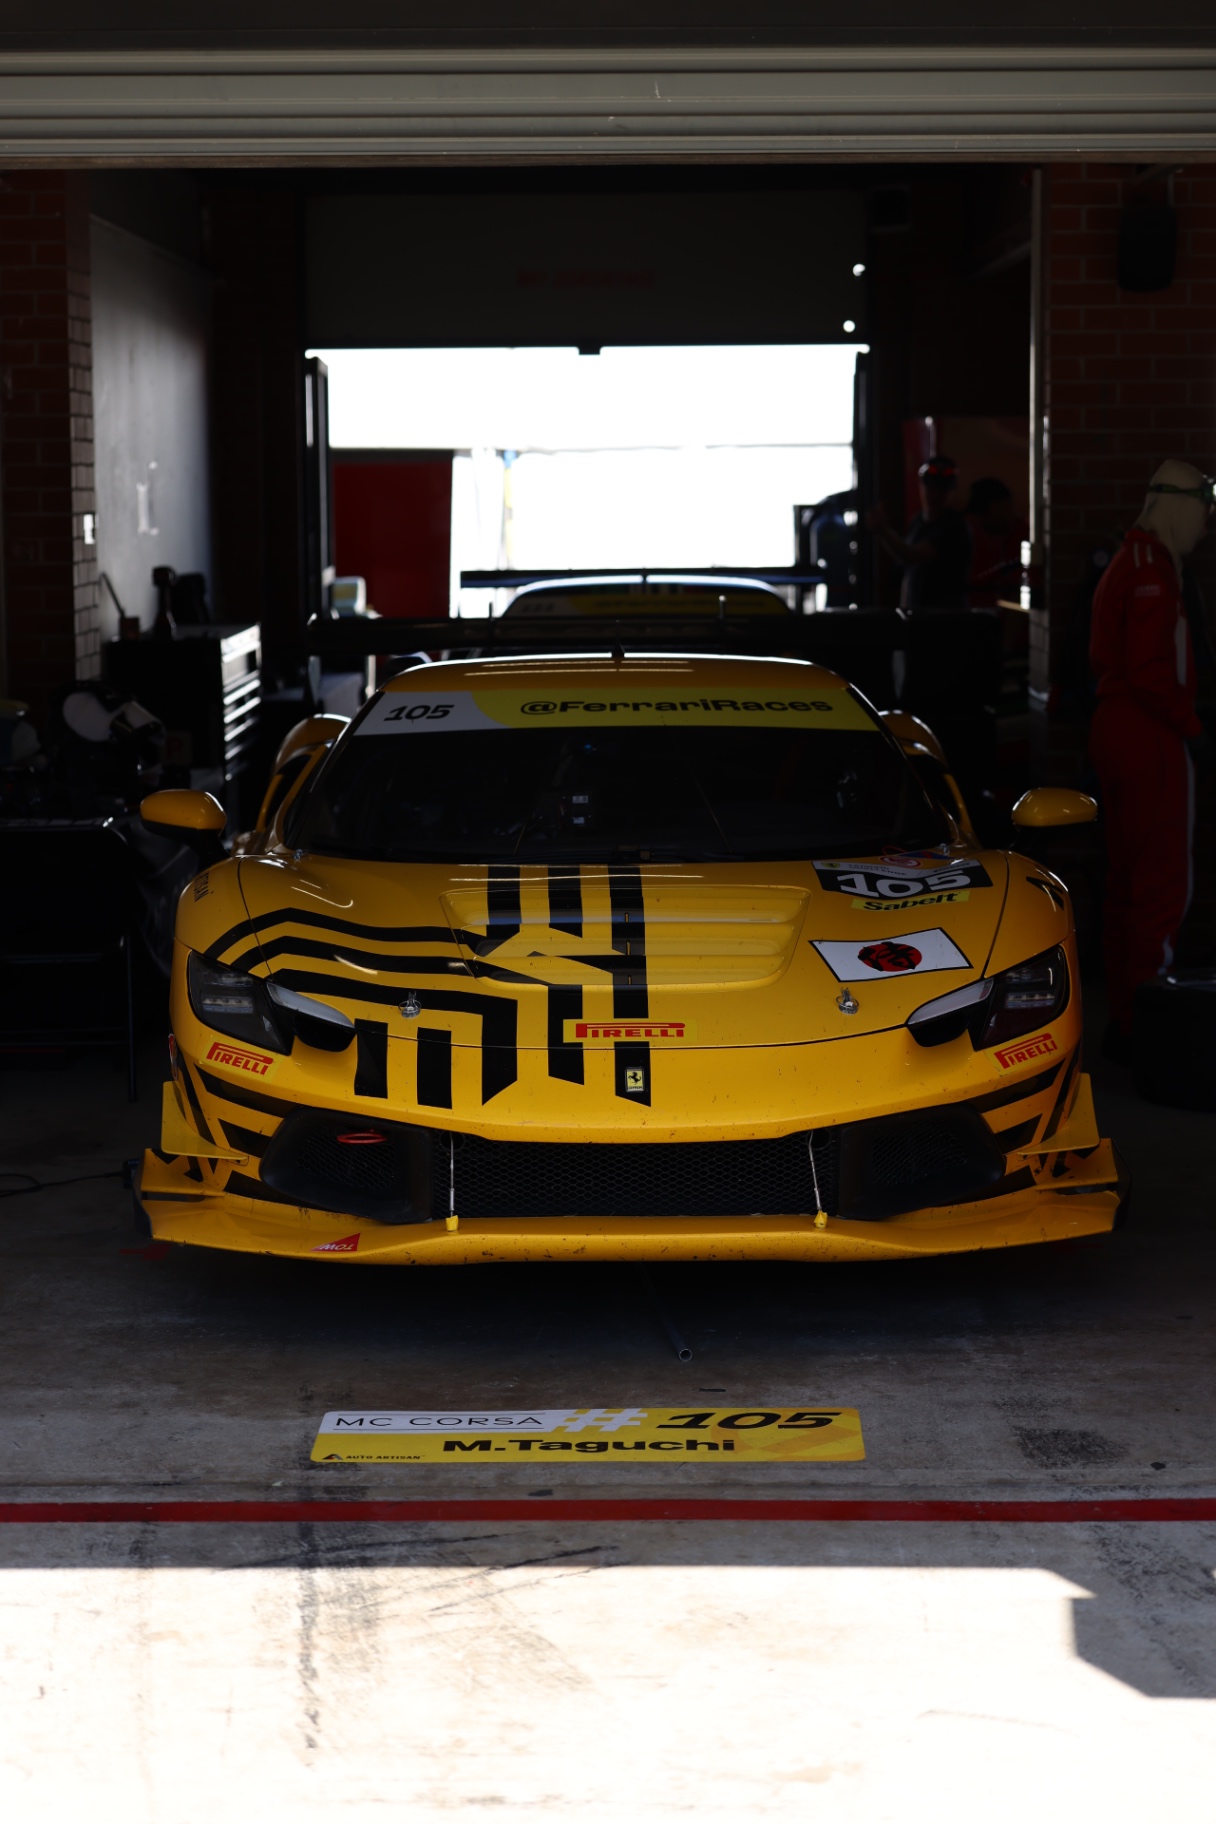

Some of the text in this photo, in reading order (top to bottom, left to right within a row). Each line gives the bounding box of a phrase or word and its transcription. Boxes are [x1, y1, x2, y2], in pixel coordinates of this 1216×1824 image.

[384, 704, 454, 721] 105
[520, 699, 833, 715] @FerrariRaces
[836, 869, 971, 898] 105
[863, 891, 959, 911] Sabelt
[575, 1022, 686, 1038] PIRELLI
[205, 1041, 274, 1076] PIRELLI
[993, 1032, 1058, 1070] PIRELLI
[318, 1243, 354, 1251] TOW
[335, 1416, 543, 1427] MC CORSA
[656, 1411, 842, 1430] 105
[443, 1438, 735, 1453] M.Taguchi
